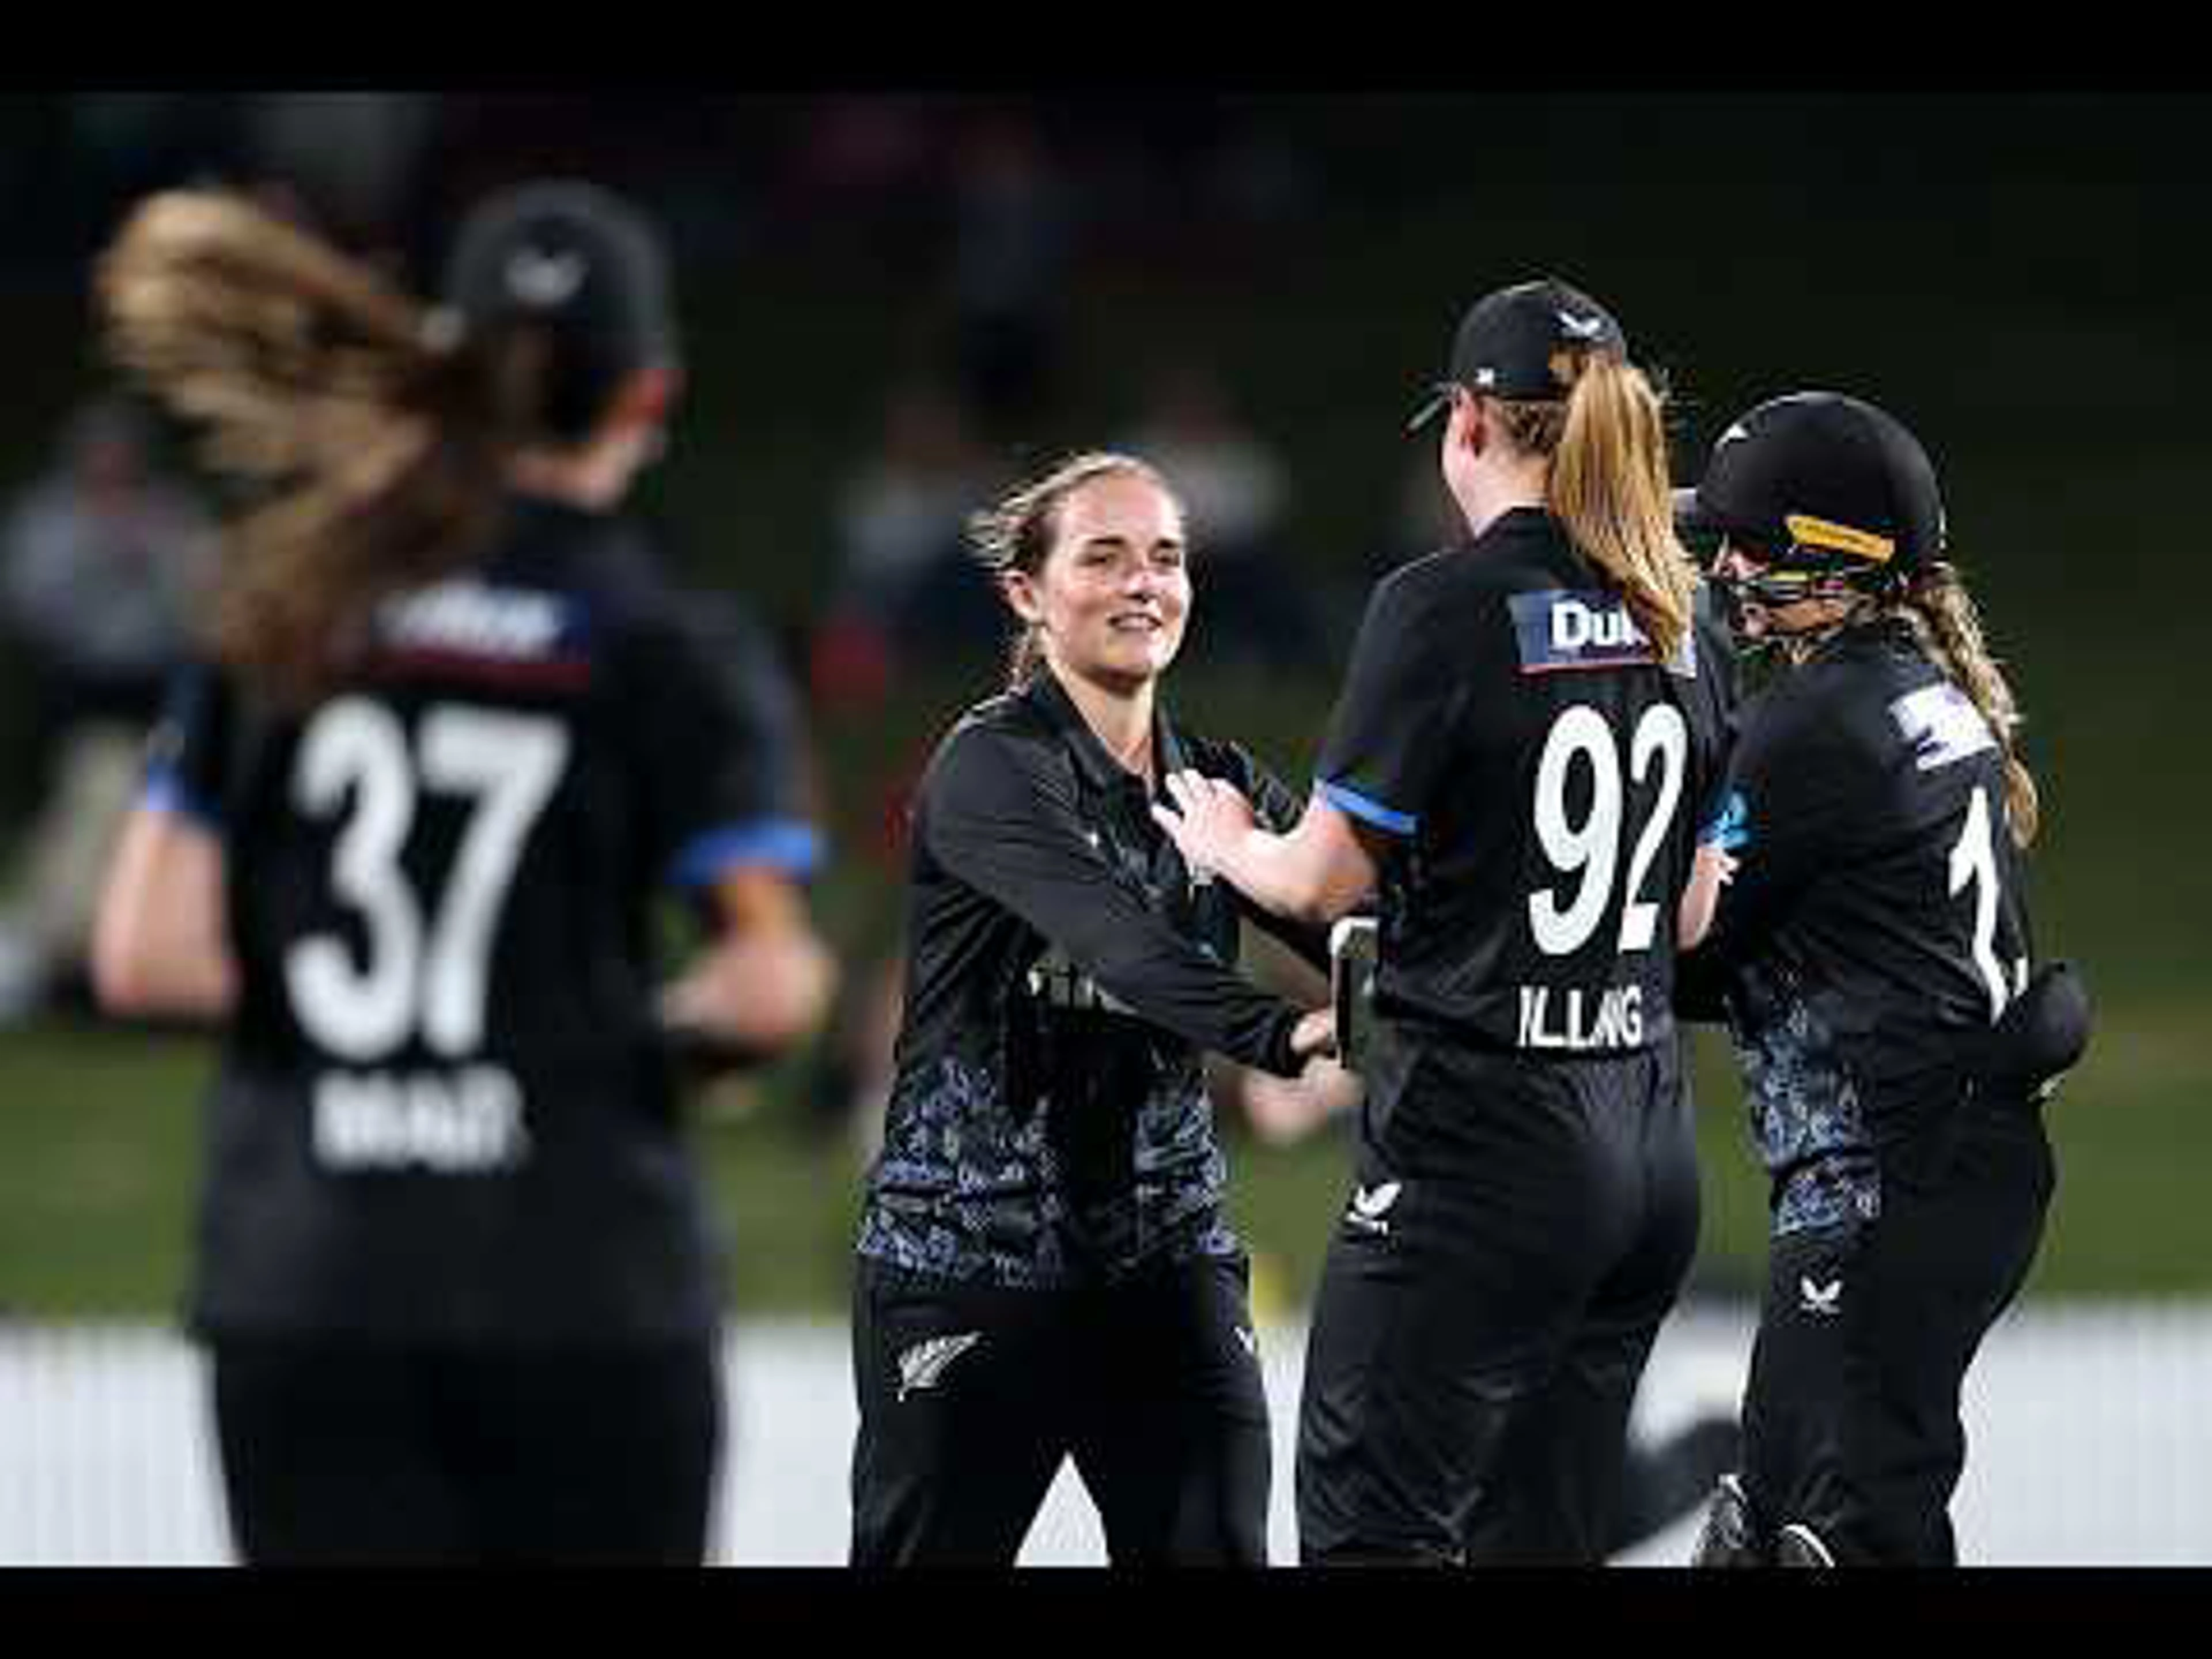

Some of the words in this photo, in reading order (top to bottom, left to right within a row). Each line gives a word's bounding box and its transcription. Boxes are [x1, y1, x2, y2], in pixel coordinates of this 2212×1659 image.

[283, 696, 569, 1061] 37
[1528, 702, 1688, 955] 92
[1948, 786, 2029, 1027] 1
